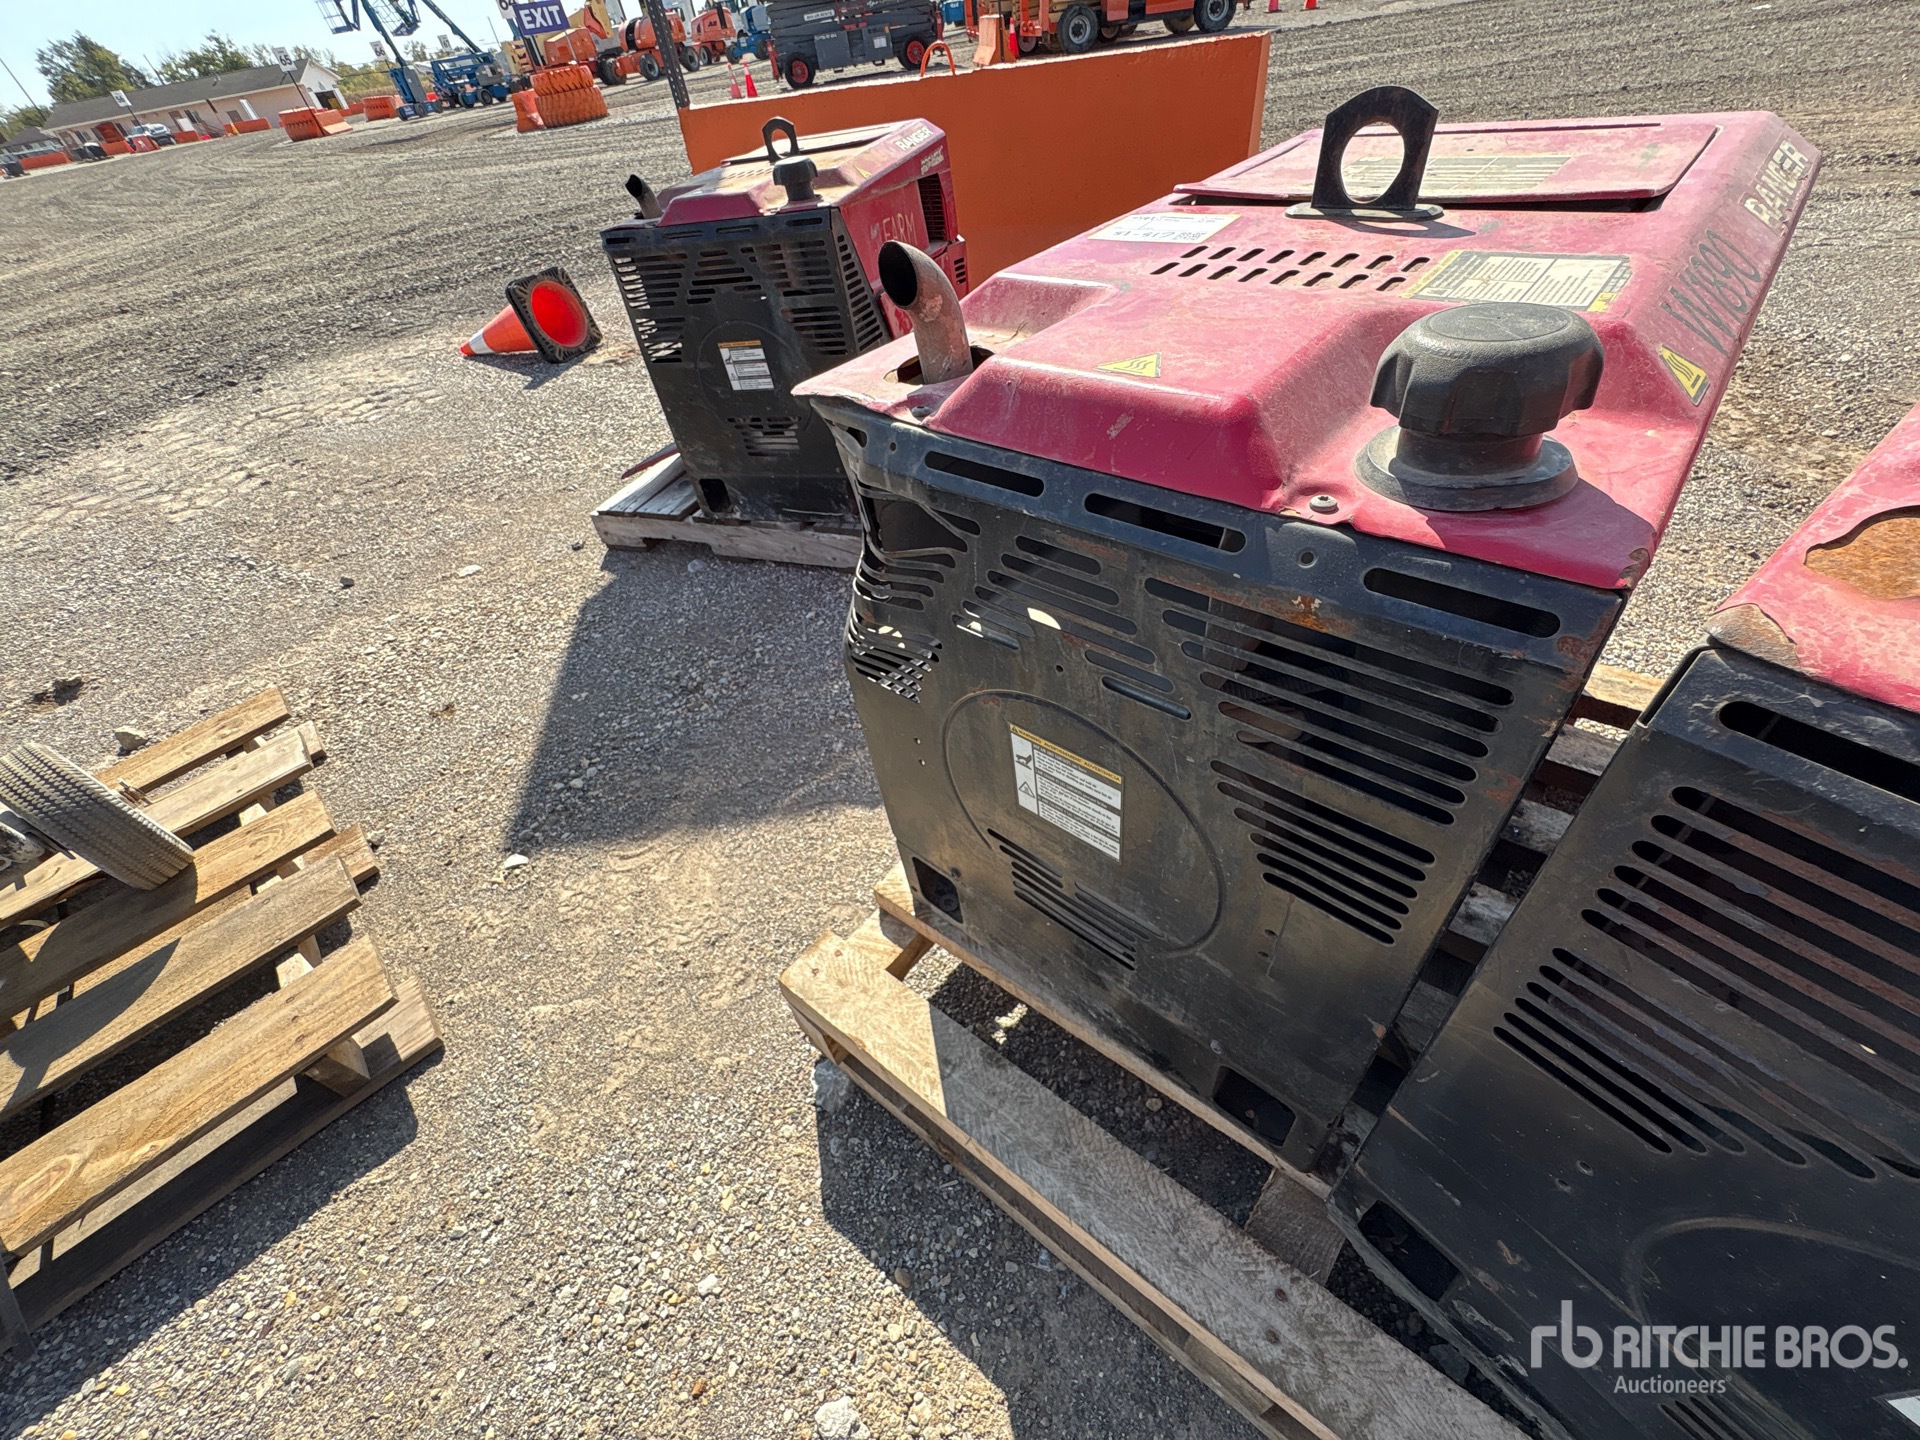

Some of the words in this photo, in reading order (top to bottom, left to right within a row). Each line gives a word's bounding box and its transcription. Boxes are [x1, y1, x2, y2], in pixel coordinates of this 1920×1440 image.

[519, 5, 562, 30] EXIT
[279, 54, 293, 66] 65
[375, 47, 386, 57] 66
[895, 126, 934, 152] RANGER
[1743, 138, 1809, 231] RANGER
[1018, 729, 1042, 744] WARNING
[1083, 760, 1121, 781] ADVERTENCIA
